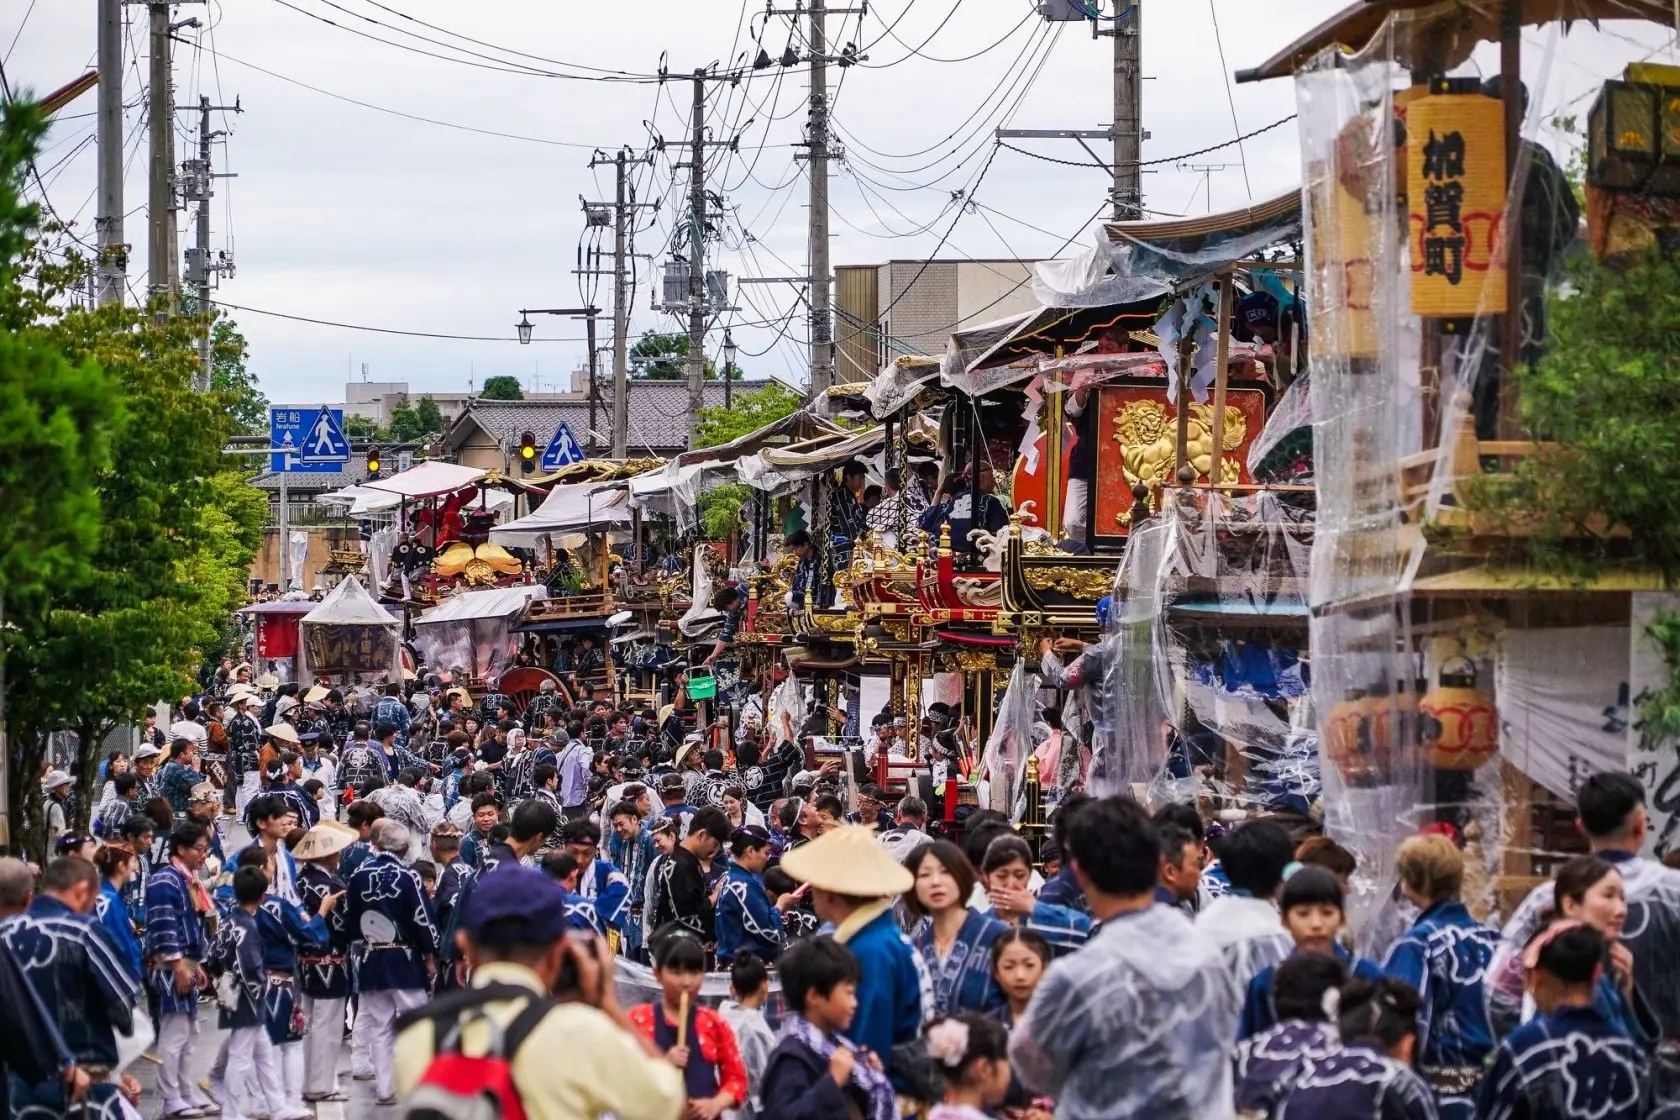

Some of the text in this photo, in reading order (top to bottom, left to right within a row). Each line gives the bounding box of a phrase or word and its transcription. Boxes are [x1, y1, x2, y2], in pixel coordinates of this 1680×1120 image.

[1422, 128, 1466, 285] 加賀町
[276, 411, 300, 423] 岩船
